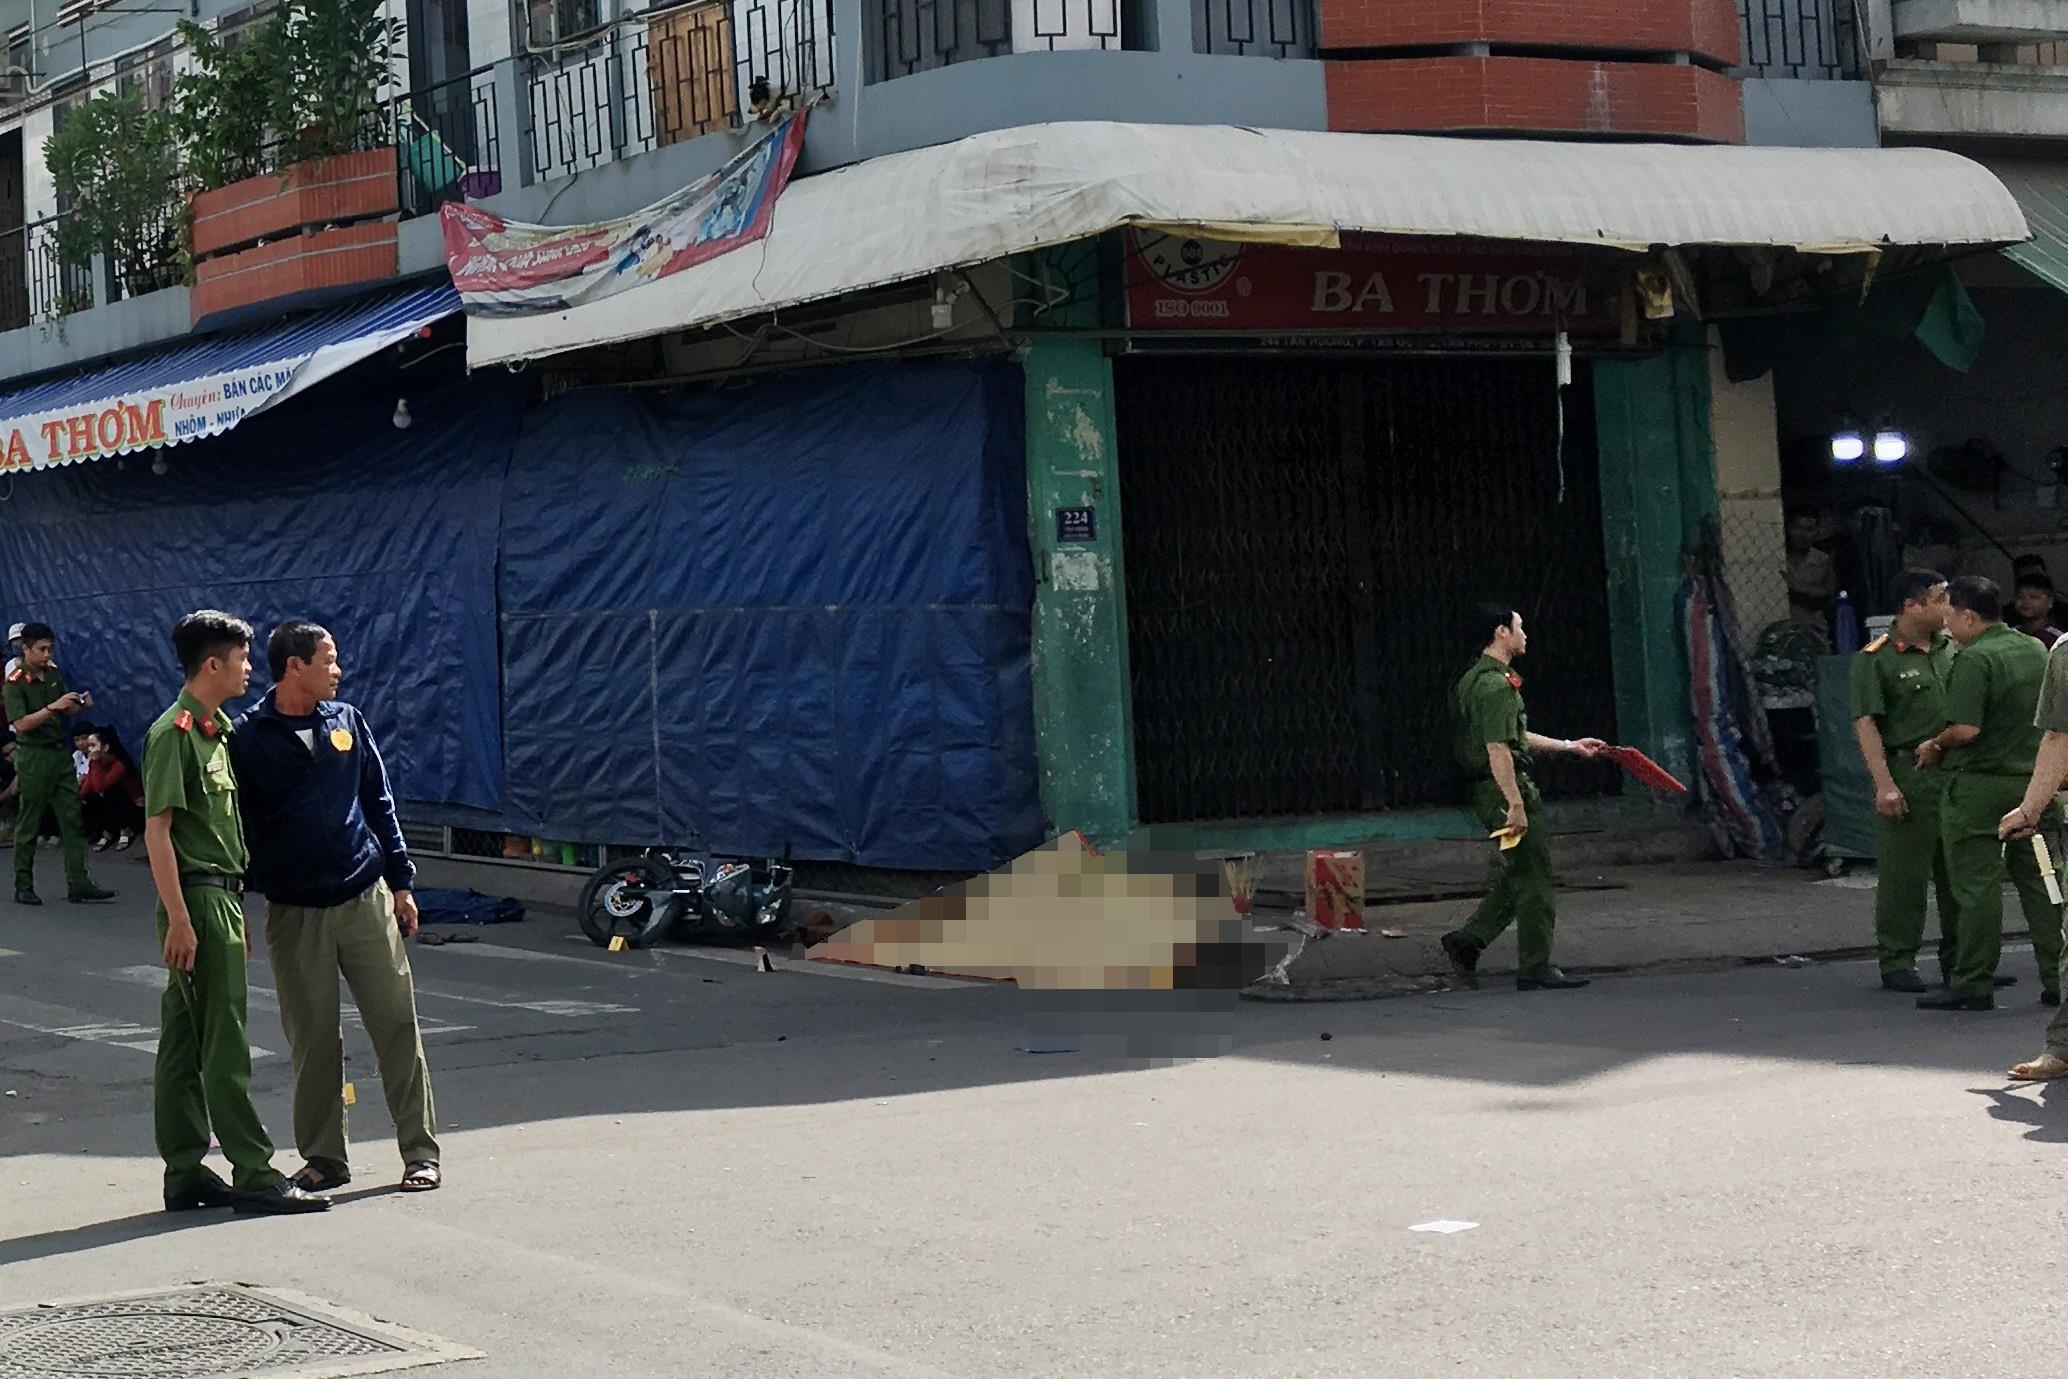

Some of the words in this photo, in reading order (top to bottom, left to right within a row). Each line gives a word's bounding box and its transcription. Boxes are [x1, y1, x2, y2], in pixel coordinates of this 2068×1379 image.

[1310, 270, 1395, 313] BA
[1416, 268, 1590, 317] THƠM
[1155, 299, 1189, 317] ISO
[1190, 299, 1230, 317] 9001
[223, 377, 247, 399] BÁN
[249, 371, 273, 394] CÁC
[0, 429, 33, 469] A
[41, 399, 169, 461] THƠM
[174, 415, 207, 437] NHÔM
[1064, 511, 1088, 524] 224
